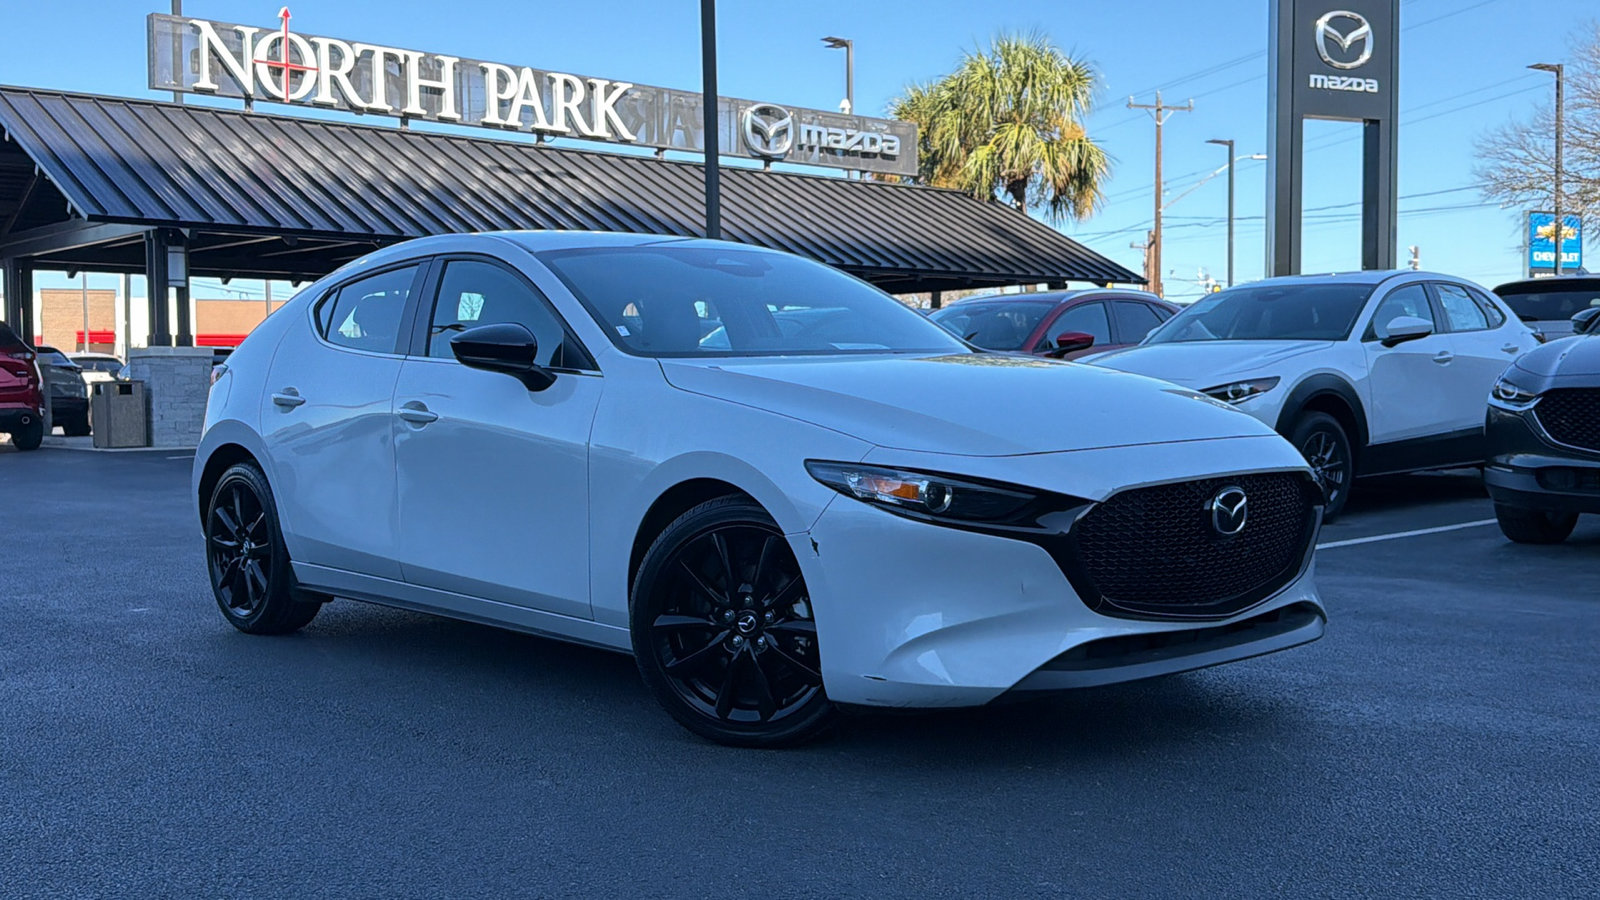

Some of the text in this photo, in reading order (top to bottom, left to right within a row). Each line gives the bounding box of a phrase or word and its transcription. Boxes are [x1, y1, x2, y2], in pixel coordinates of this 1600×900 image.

[190, 19, 461, 121] NORTH
[478, 62, 637, 142] PARK
[1533, 251, 1579, 262] CHEVOLET
